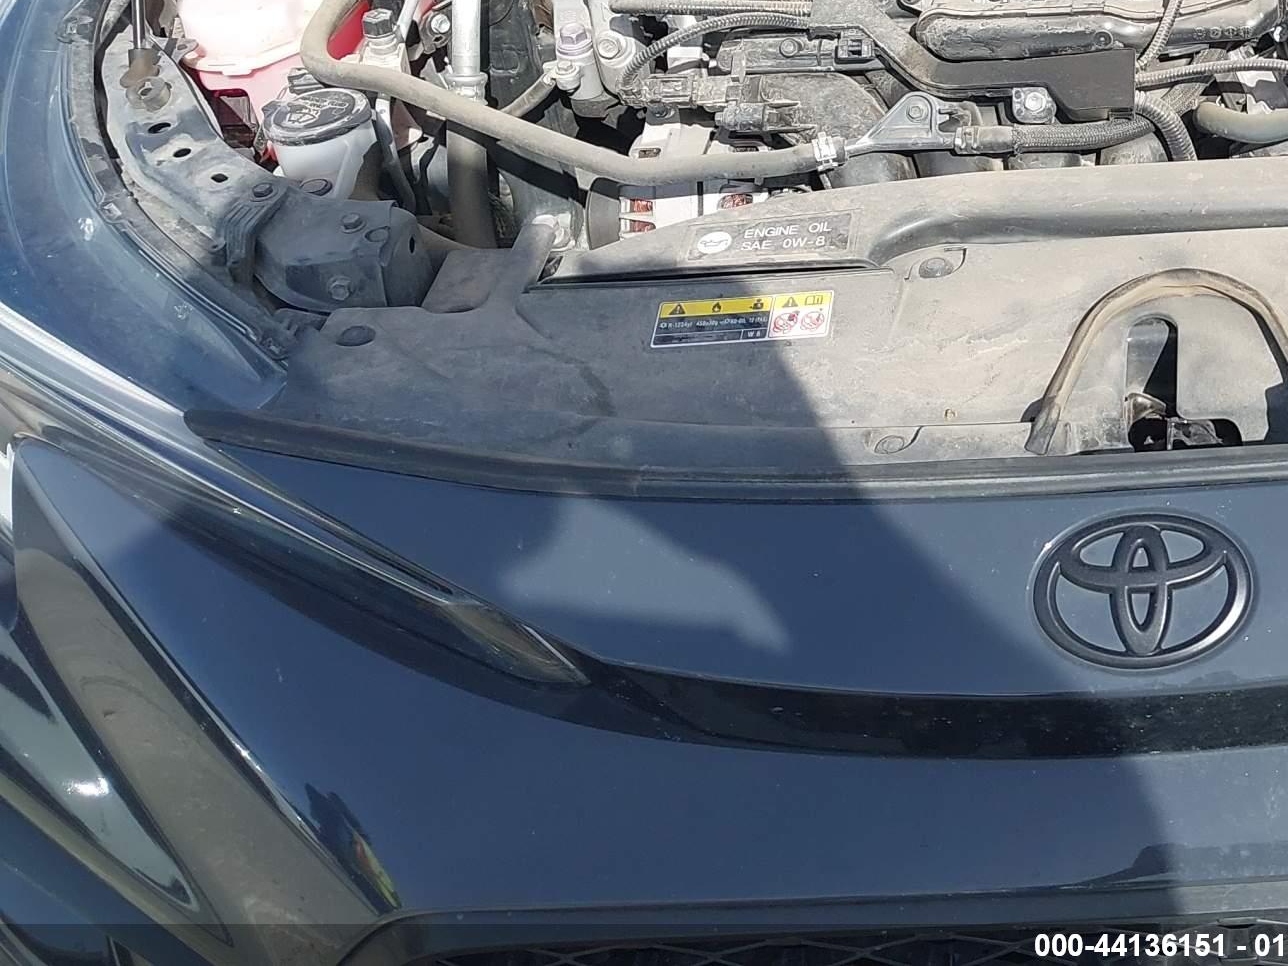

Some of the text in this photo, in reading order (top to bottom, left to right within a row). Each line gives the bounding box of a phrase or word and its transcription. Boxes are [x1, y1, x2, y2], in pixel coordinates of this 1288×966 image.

[744, 221, 832, 238] ENGINE OIL
[741, 235, 825, 250] SAE 0W-8
